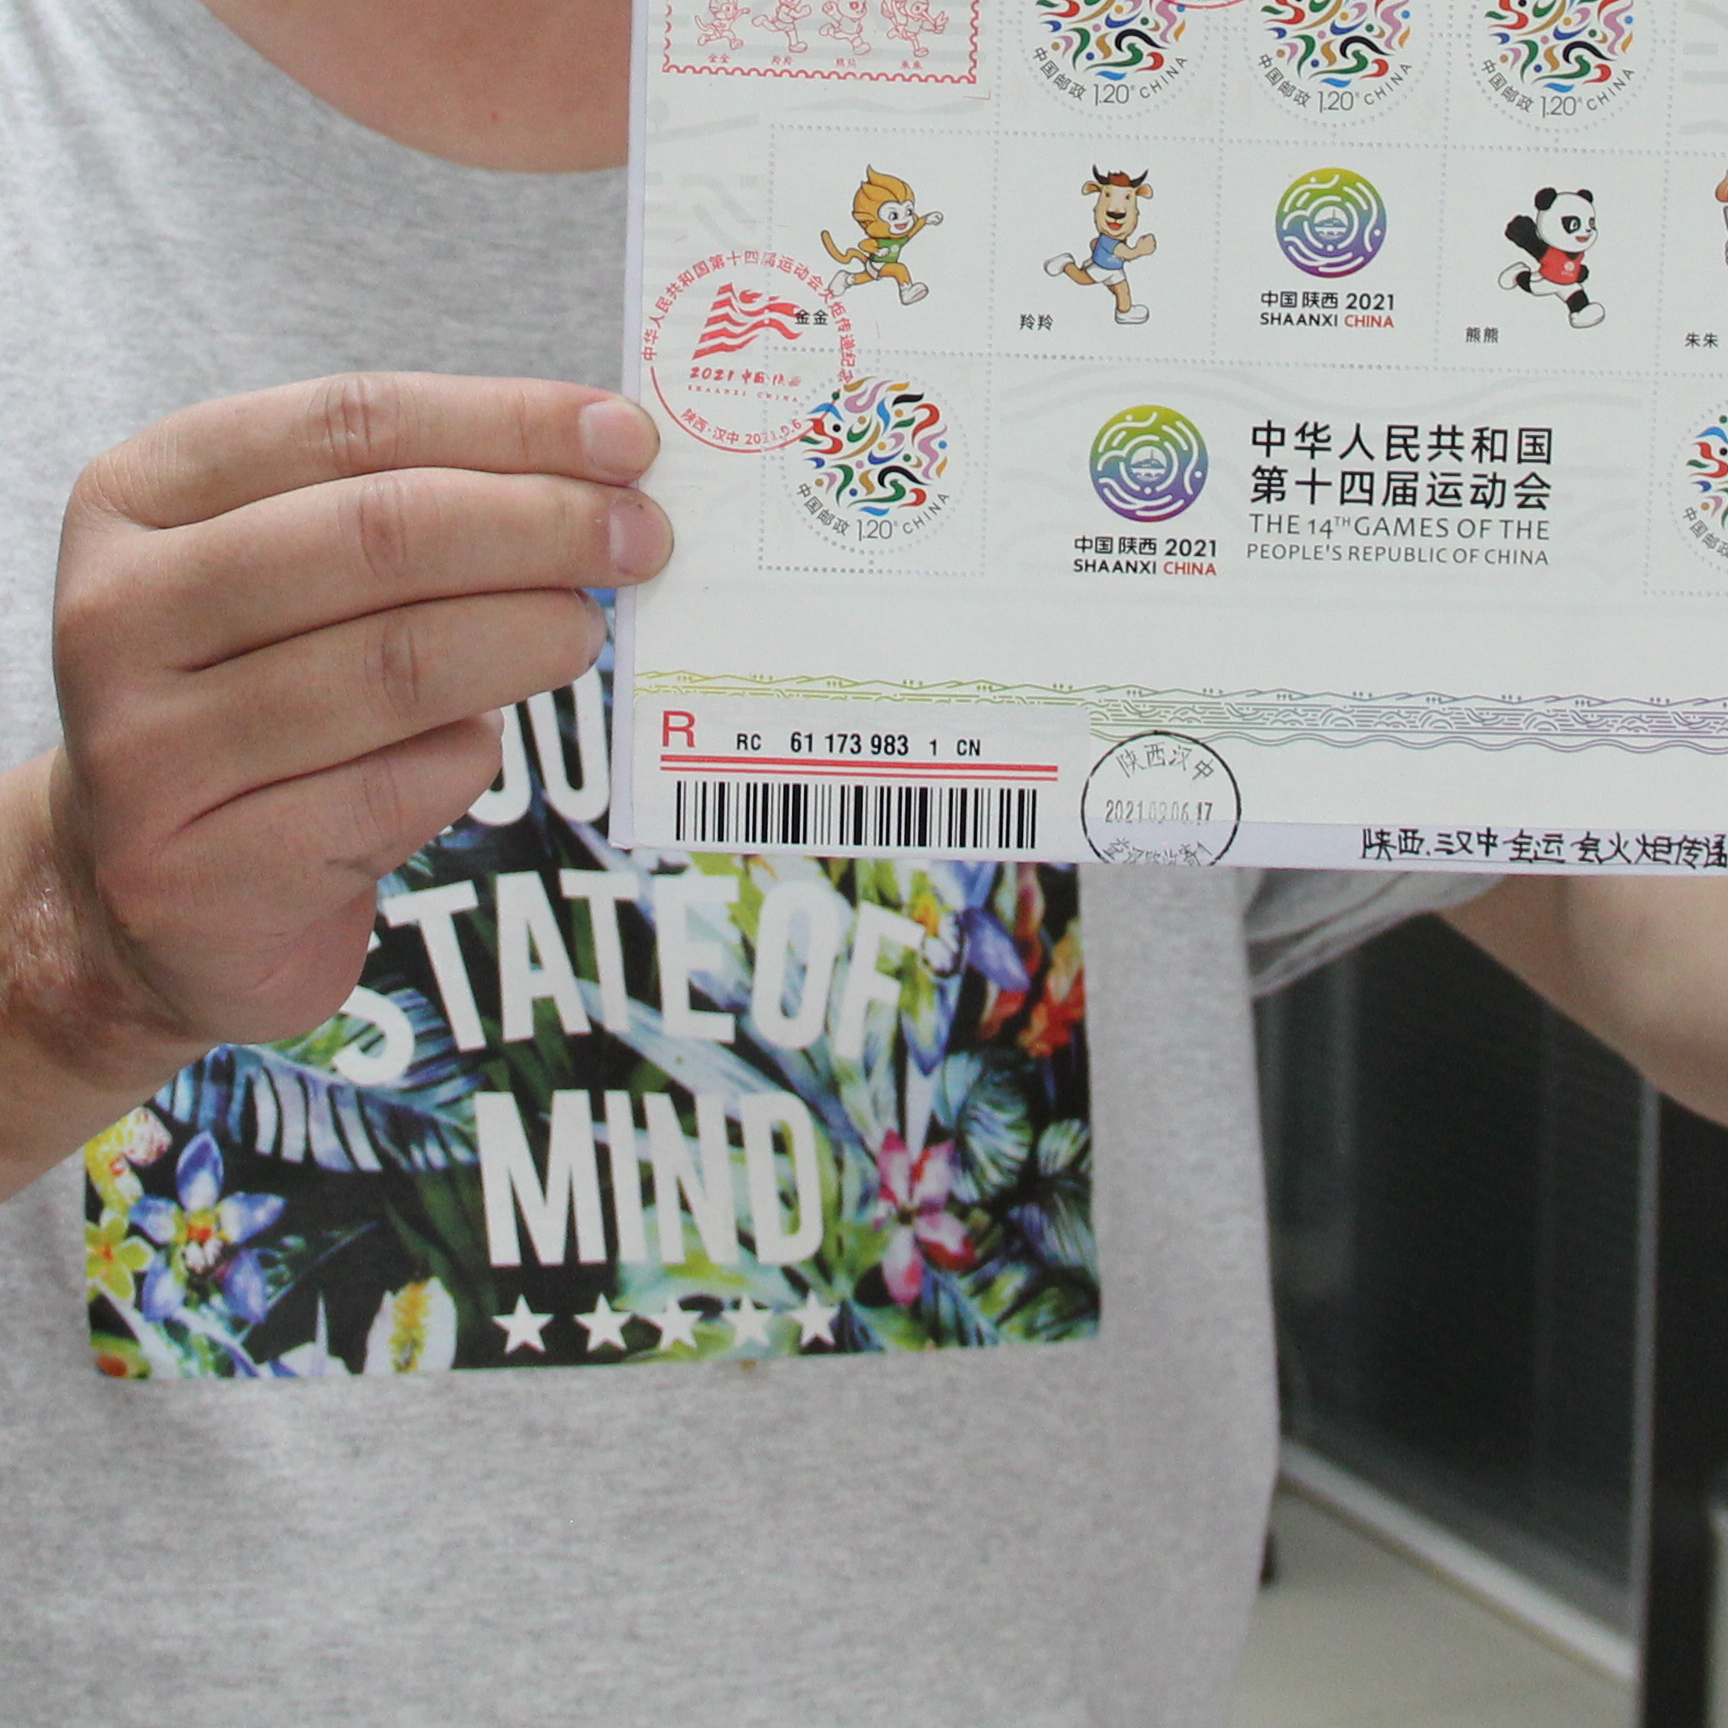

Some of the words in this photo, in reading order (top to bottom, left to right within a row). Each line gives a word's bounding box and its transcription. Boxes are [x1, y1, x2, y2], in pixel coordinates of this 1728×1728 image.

[1033, 47, 1086, 101] 中国邮政
[1139, 56, 1188, 99] CHINA
[1258, 54, 1311, 108] 中国邮政
[1364, 62, 1412, 105] CHINA
[1481, 59, 1534, 113] 中国邮政
[1586, 68, 1635, 111] CHINA
[1346, 293, 1394, 310] 2021
[795, 309, 828, 325] 金金
[1019, 313, 1054, 331] 羚羚
[1260, 312, 1338, 327] SHAANXI
[1344, 314, 1394, 328] CHINA
[1466, 326, 1499, 343] 熊熊
[1685, 332, 1719, 348] 朱朱
[690, 366, 735, 382] 2021
[1252, 420, 1552, 465] 中华人民共和国
[1251, 465, 1551, 511] 第十四届运动会
[797, 483, 850, 536] 中国邮政
[902, 492, 950, 535] CHINA
[1249, 513, 1300, 535] THE
[1354, 516, 1450, 539] GAMES
[1457, 518, 1493, 539] OF
[1499, 519, 1550, 541] THE
[1164, 538, 1217, 558] 2021
[1247, 543, 1342, 562] PEOPLE'S
[1348, 545, 1447, 564] REPUBLIC
[1453, 547, 1480, 564] OF
[1484, 548, 1549, 566] CHINA
[1073, 559, 1157, 575] SHAANXI
[1163, 561, 1217, 576] CHINA
[662, 710, 696, 748] R
[735, 733, 762, 751] RC
[790, 732, 813, 753] 61
[824, 733, 861, 754] 173
[870, 735, 909, 756] 983
[929, 739, 938, 756] 1
[956, 739, 981, 757] CN
[1115, 741, 1215, 781] 陕西汉中
[475, 1089, 824, 1267] MIND
